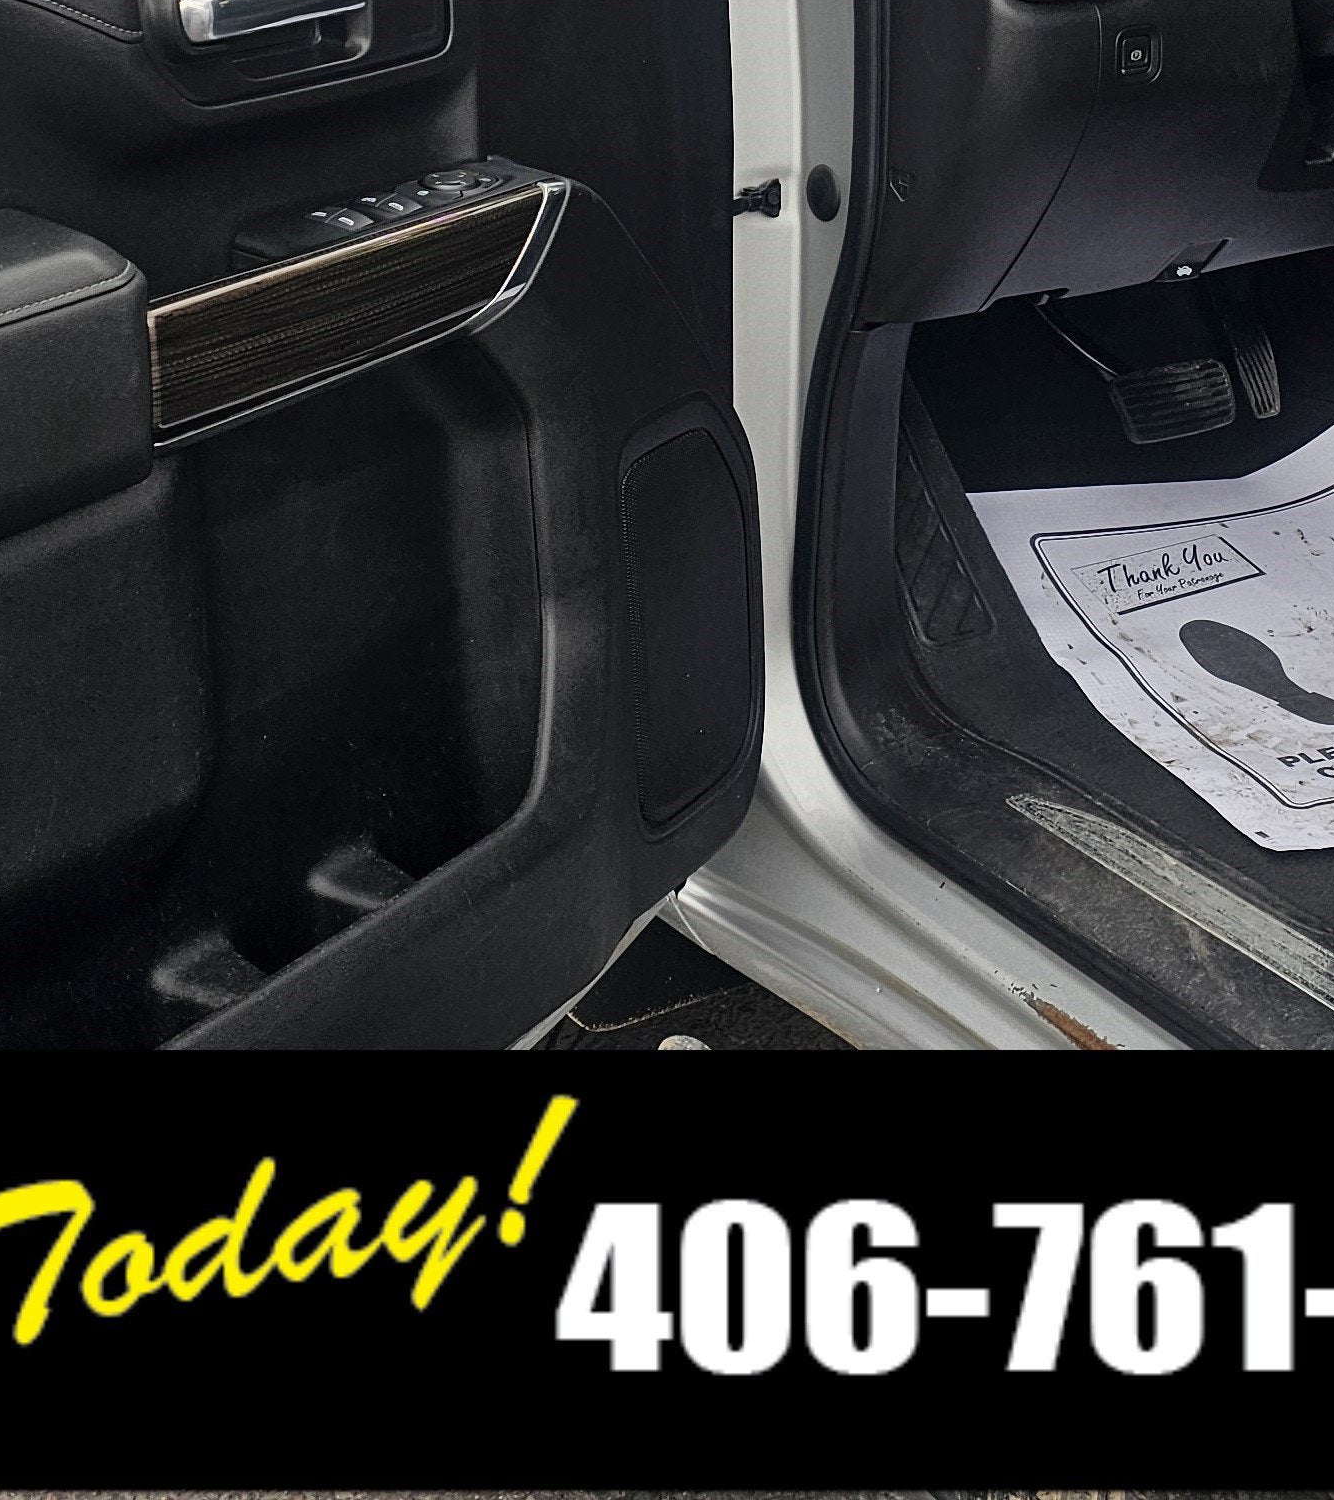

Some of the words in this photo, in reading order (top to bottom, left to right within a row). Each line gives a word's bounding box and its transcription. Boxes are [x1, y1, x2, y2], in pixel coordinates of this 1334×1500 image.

[1097, 553, 1181, 593] Thank
[1183, 544, 1229, 572] You
[1137, 587, 1155, 601] For
[1156, 583, 1178, 596] Your
[1178, 571, 1225, 589] Patronage
